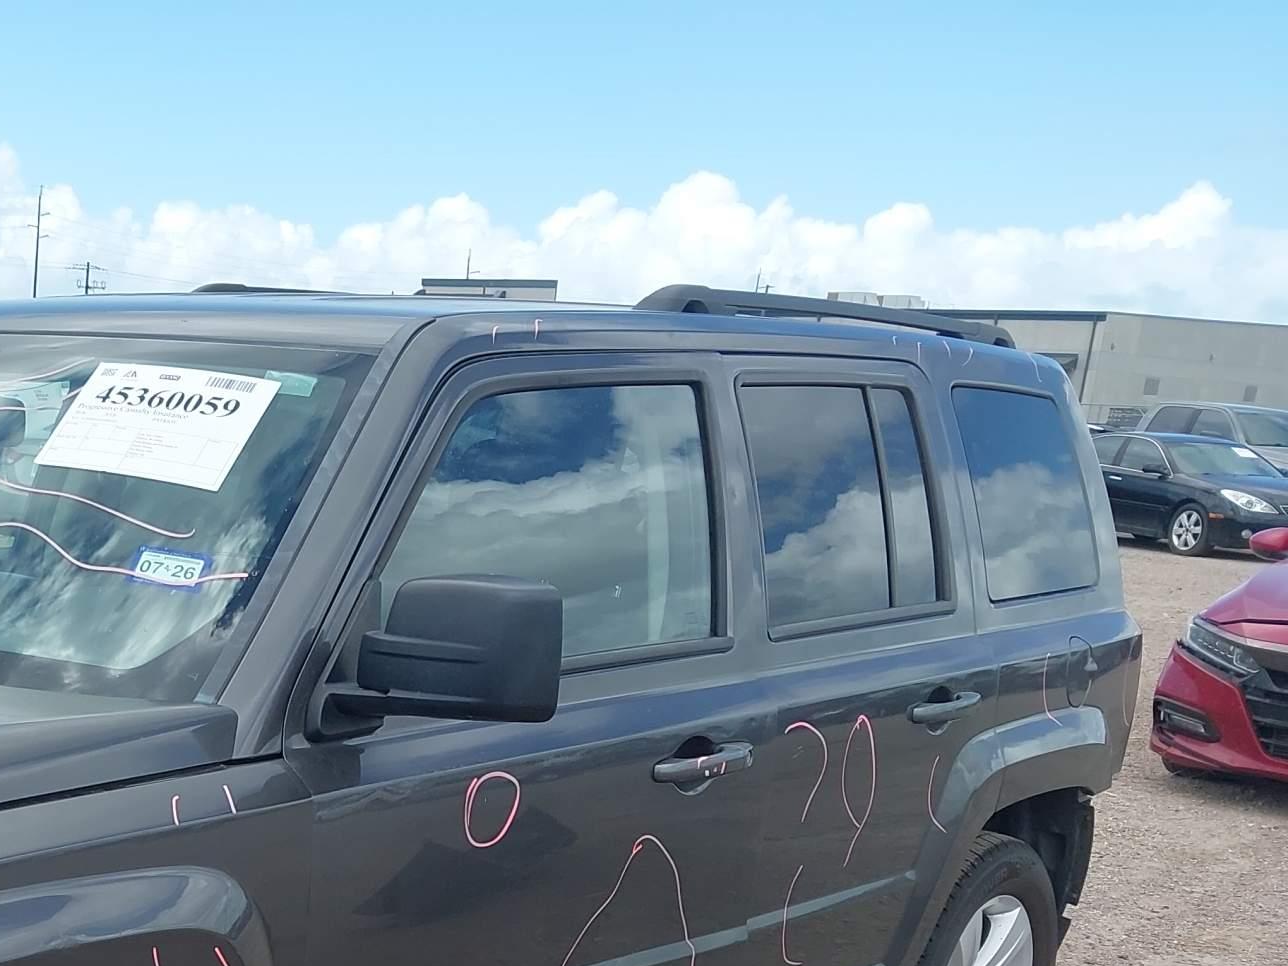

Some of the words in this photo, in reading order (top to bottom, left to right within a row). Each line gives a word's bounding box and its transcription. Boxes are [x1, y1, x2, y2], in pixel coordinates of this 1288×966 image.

[96, 385, 240, 417] 45360059
[140, 560, 164, 574] 07
[171, 564, 196, 580] 26
